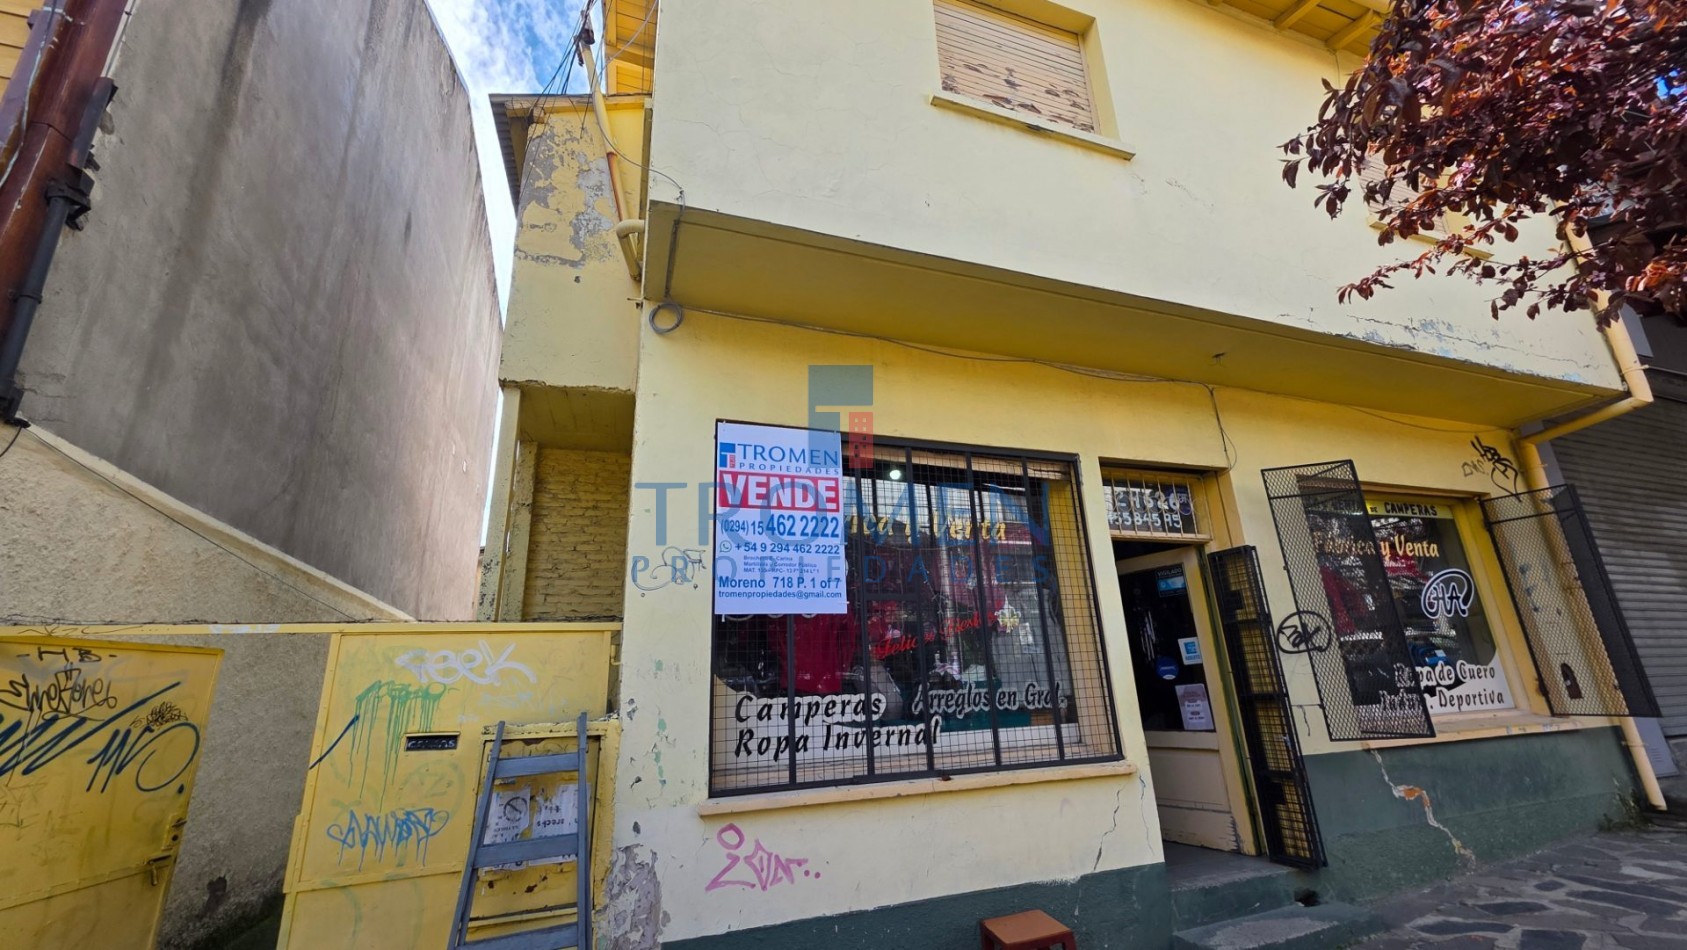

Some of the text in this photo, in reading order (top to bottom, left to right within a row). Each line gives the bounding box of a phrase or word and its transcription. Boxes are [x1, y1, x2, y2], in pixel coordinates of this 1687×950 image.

[737, 443, 838, 466] TROMEN
[739, 462, 839, 475] PROPIEDADES
[723, 473, 837, 510] VENDE
[1384, 502, 1438, 516] CAMPERAS
[720, 514, 840, 538] (0294) 15 462 2222
[760, 543, 767, 553] 9
[769, 543, 789, 553] 294
[792, 543, 812, 554] 462
[815, 544, 840, 555] 2222
[1381, 541, 1390, 561] y
[1394, 534, 1439, 558] Venta
[719, 576, 840, 589] Moreno 718 P. 1 of 7
[719, 590, 842, 599] tromenpropiedades@gmail.com
[1440, 661, 1453, 681] de
[1459, 662, 1496, 680] Cuero
[998, 689, 1018, 708] en
[1439, 689, 1505, 712] Deportiva
[735, 694, 882, 726] Camperas
[735, 718, 940, 762] Ropa Invernal
